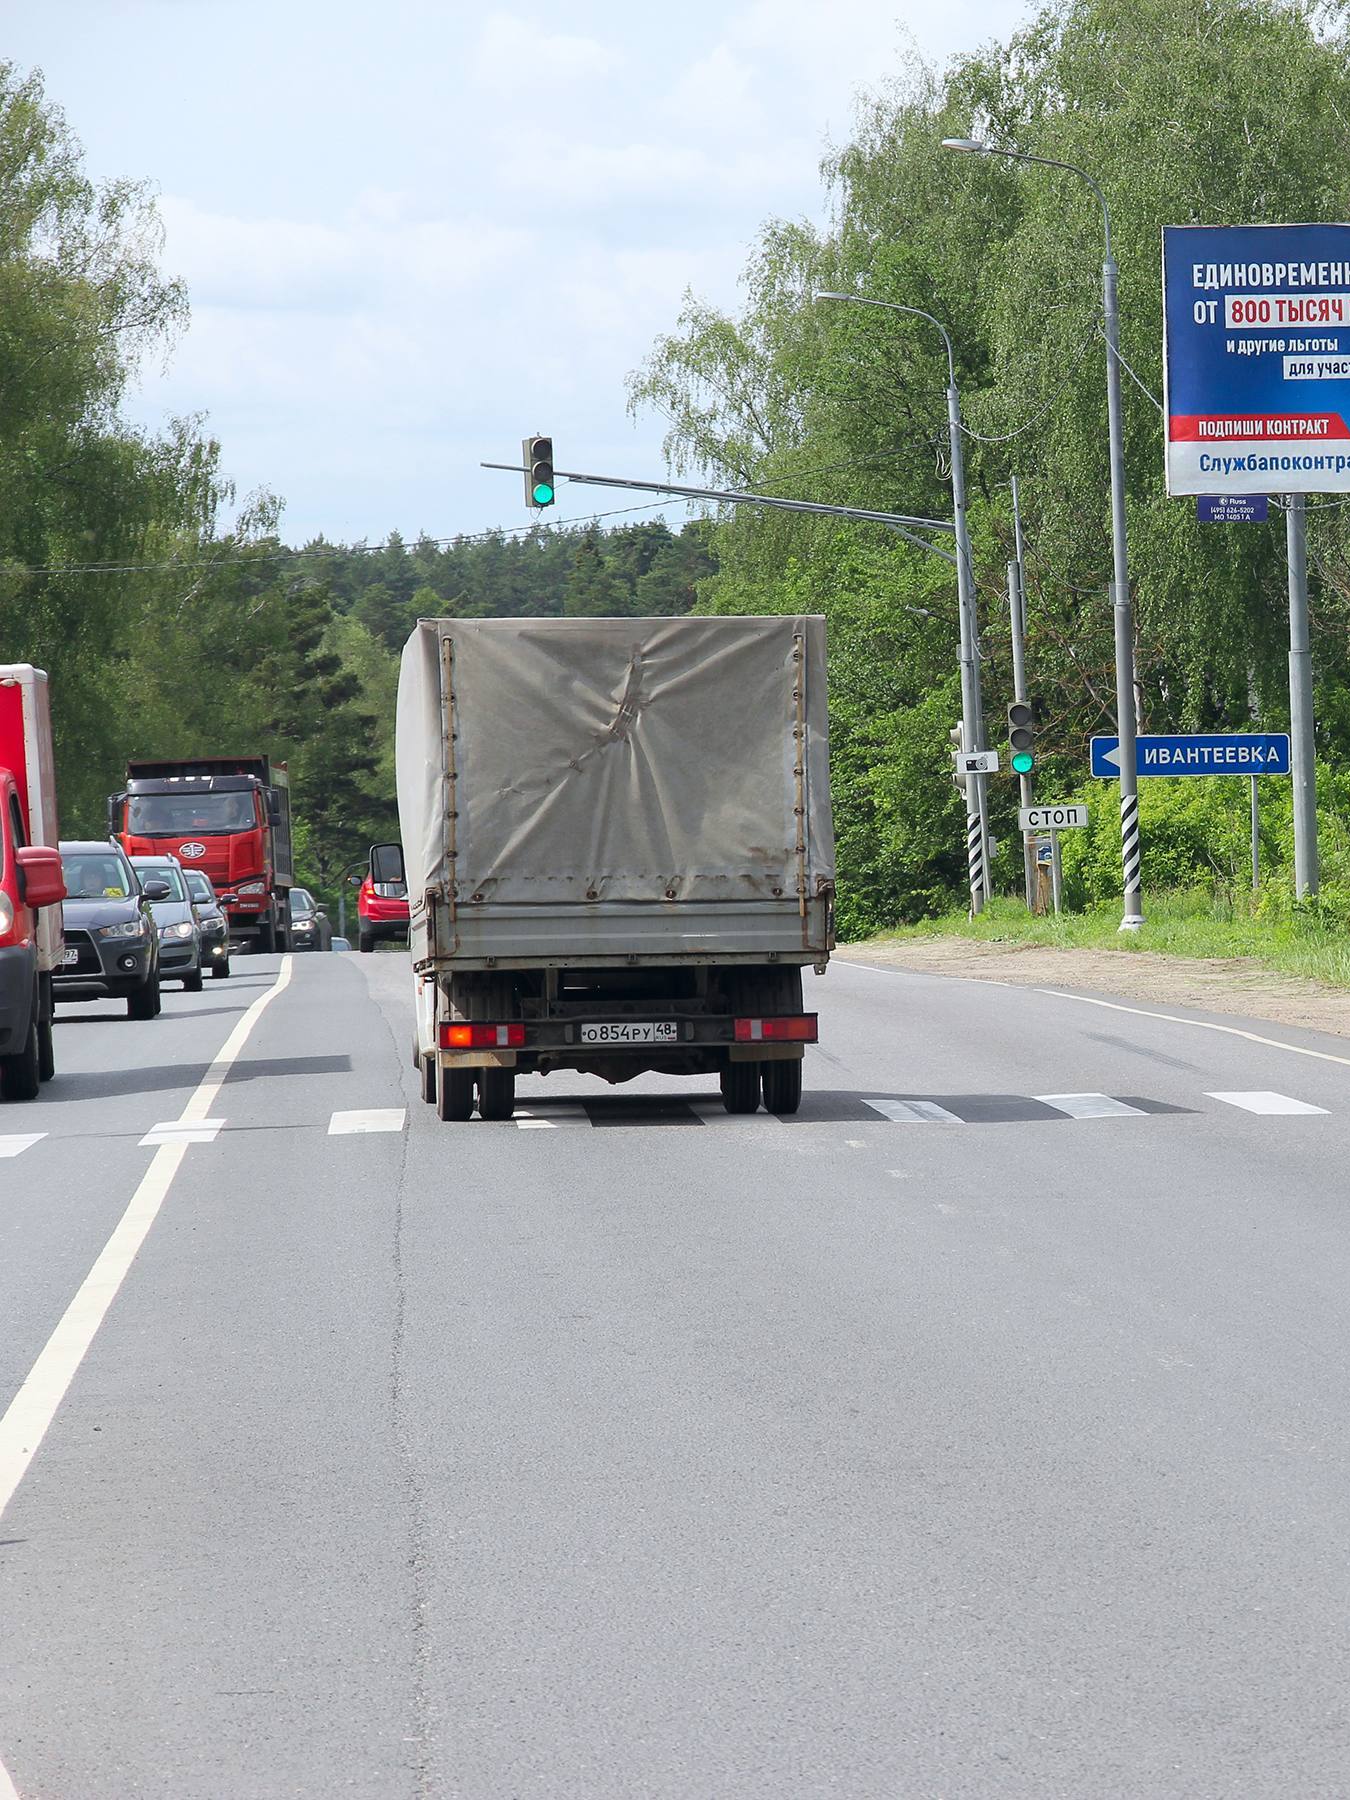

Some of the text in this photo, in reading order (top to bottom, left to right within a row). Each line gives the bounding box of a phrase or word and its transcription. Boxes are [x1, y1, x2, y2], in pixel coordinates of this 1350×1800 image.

[1194, 301, 1218, 324] ОТ
[1232, 301, 1270, 323] 800
[1275, 299, 1342, 322] ТЫСЯЧ
[1227, 338, 1338, 356] и другие льготы
[1289, 361, 1314, 376] для
[1199, 419, 1329, 436] ПОДПИШИ КОНТРАКТ
[1144, 746, 1280, 765] ИВАНТЕЕВКА
[1028, 809, 1078, 827] СТОП
[656, 1024, 671, 1035] 48
